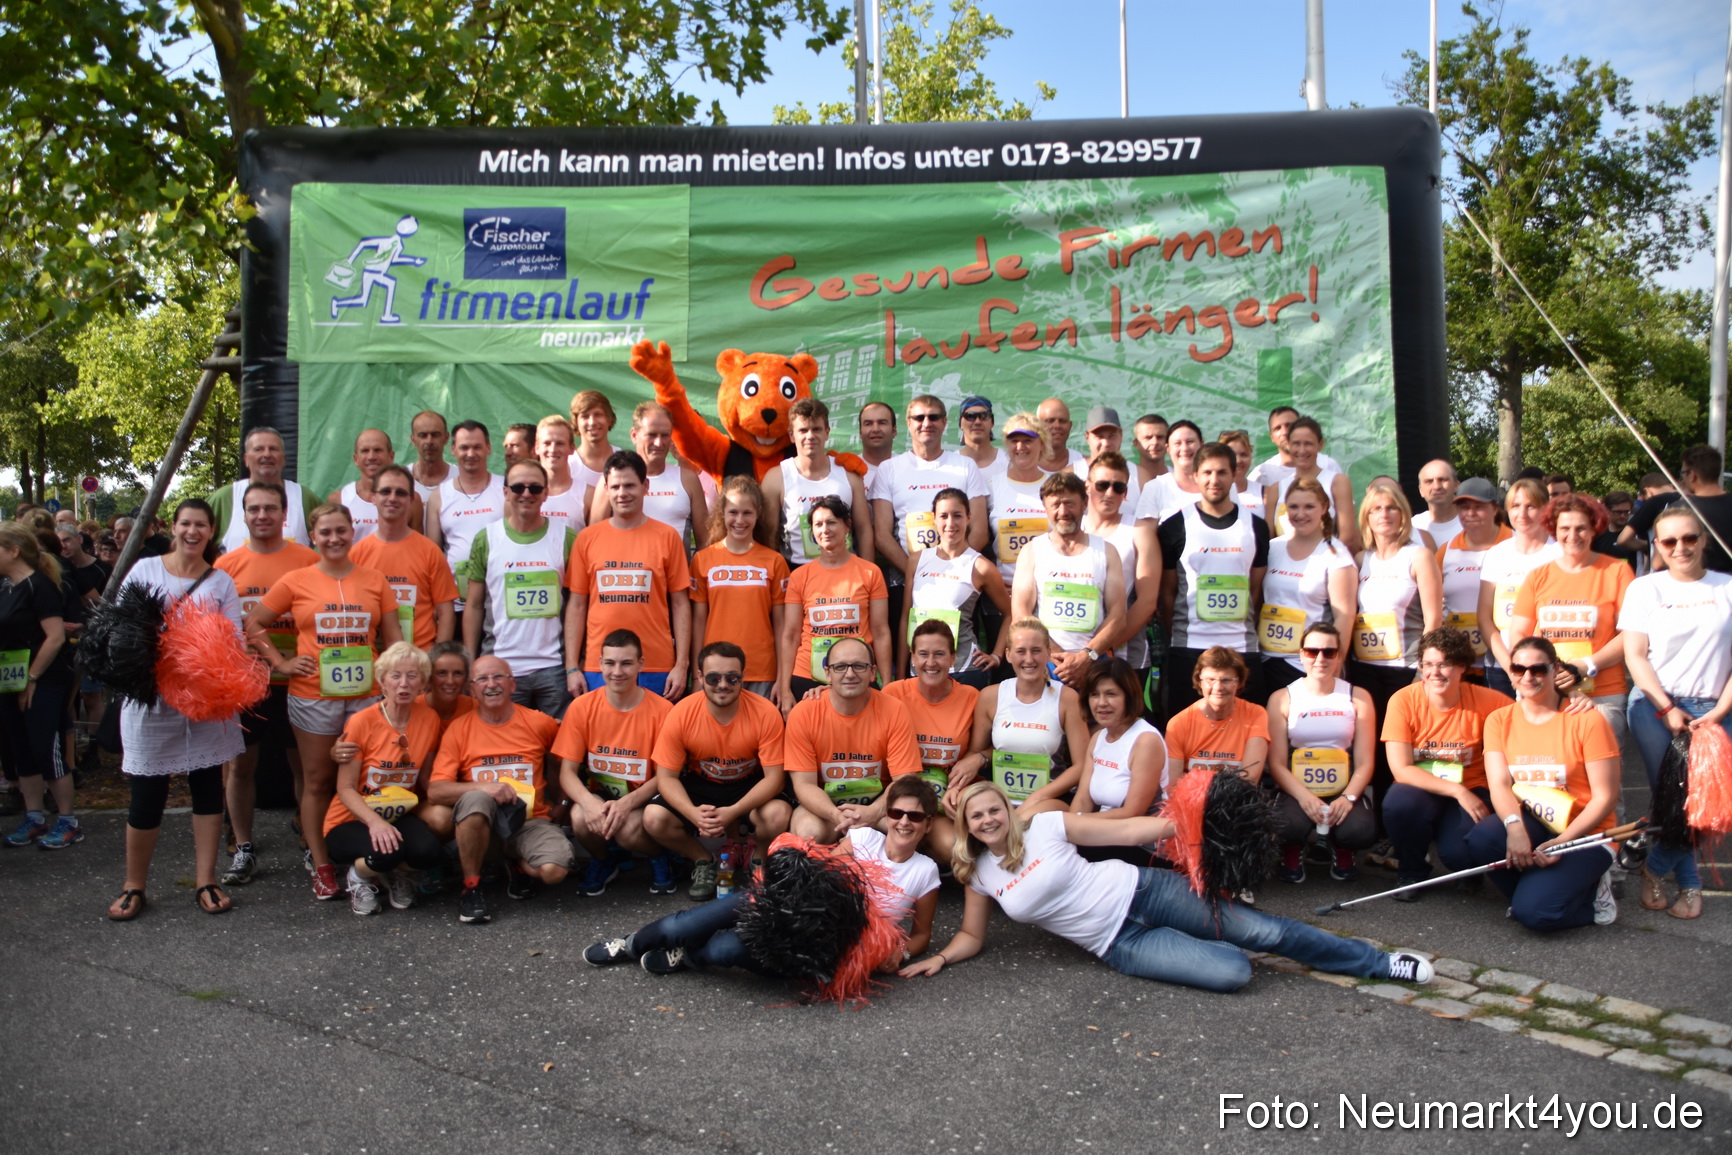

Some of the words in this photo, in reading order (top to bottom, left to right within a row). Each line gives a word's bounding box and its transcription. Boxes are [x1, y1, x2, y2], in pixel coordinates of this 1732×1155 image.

[479, 149, 549, 173] Mich
[560, 149, 629, 173] kann
[639, 155, 701, 172] man
[713, 147, 824, 171] mieten!
[835, 147, 906, 170] Infos
[914, 148, 993, 169] unter
[1001, 137, 1202, 165] 0173-8299577
[483, 228, 551, 243] Fischer
[748, 235, 1029, 310] Gesunde
[1059, 224, 1284, 274] Firmen
[418, 278, 655, 320] firmenlauf
[884, 298, 1078, 367] laufen
[1109, 265, 1321, 363] länger!
[540, 326, 645, 347] neumarkt
[601, 574, 647, 587] OBI
[712, 569, 763, 581] OBI
[516, 590, 549, 606] 578
[599, 593, 650, 604] Neumarkt
[815, 597, 827, 605] 30
[1207, 593, 1238, 609] 593
[325, 603, 337, 611] 30
[340, 603, 363, 611] Jahre
[1053, 601, 1087, 618] 585
[812, 608, 856, 622] OBI
[1543, 611, 1592, 622] OBI
[320, 616, 367, 629] OBI
[811, 625, 859, 635] Neumarkt
[1266, 623, 1294, 641] 594
[317, 633, 369, 645] Neumarkt
[1361, 631, 1387, 648] 597
[332, 666, 364, 682] 613
[1013, 722, 1050, 731] KLEBL
[929, 735, 953, 744] Jahre
[597, 745, 610, 754] 30
[613, 747, 638, 757] Jahre
[832, 752, 846, 761] 30
[848, 752, 873, 761] Jahre
[1198, 750, 1210, 758] 30
[1212, 751, 1236, 759] Jahre
[380, 760, 393, 768] 30
[481, 756, 495, 765] 30
[498, 755, 523, 764] Jahre
[593, 758, 641, 776] OBI
[372, 772, 417, 785] OBI
[478, 768, 528, 783] OBI
[826, 765, 879, 779] OBI
[1303, 768, 1337, 784] 596
[1513, 769, 1559, 782] OBI
[1004, 771, 1038, 789] 617
[1006, 858, 1044, 890] KLEBL
